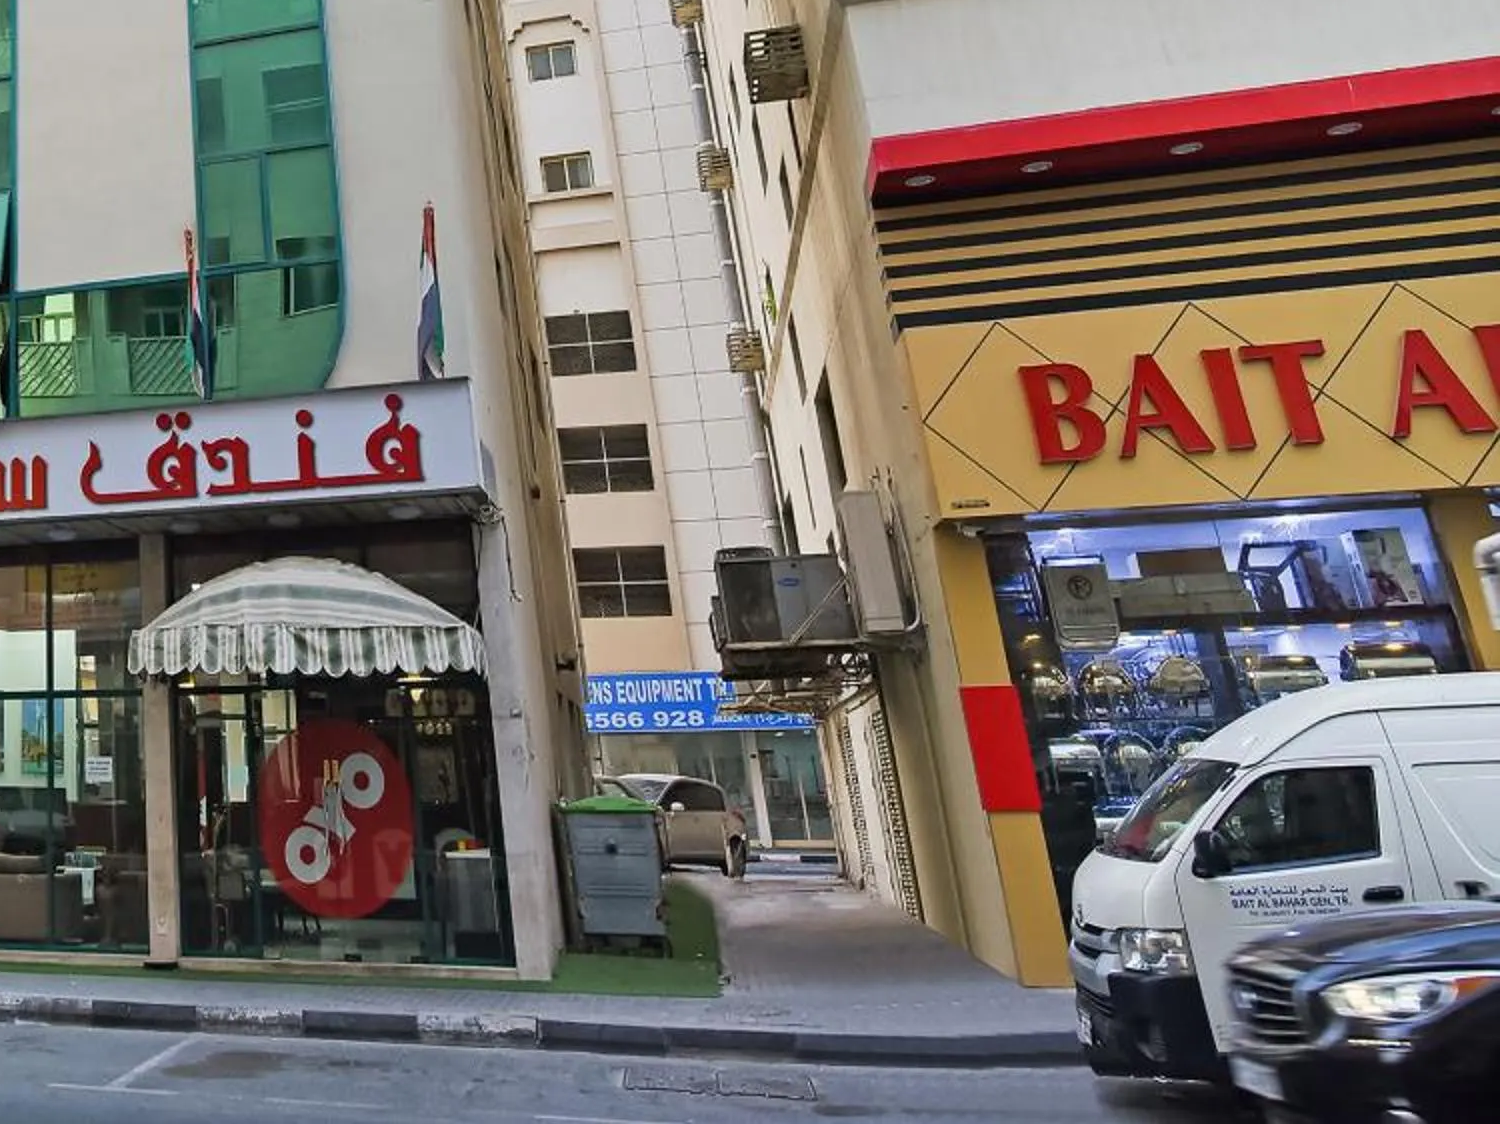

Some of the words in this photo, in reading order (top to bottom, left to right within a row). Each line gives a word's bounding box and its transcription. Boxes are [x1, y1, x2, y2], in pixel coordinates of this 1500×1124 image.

[1017, 339, 1325, 464] BAIT
[79, 393, 425, 504] فندق
[616, 677, 704, 704] EQUIPMENT
[653, 710, 706, 727] 928
